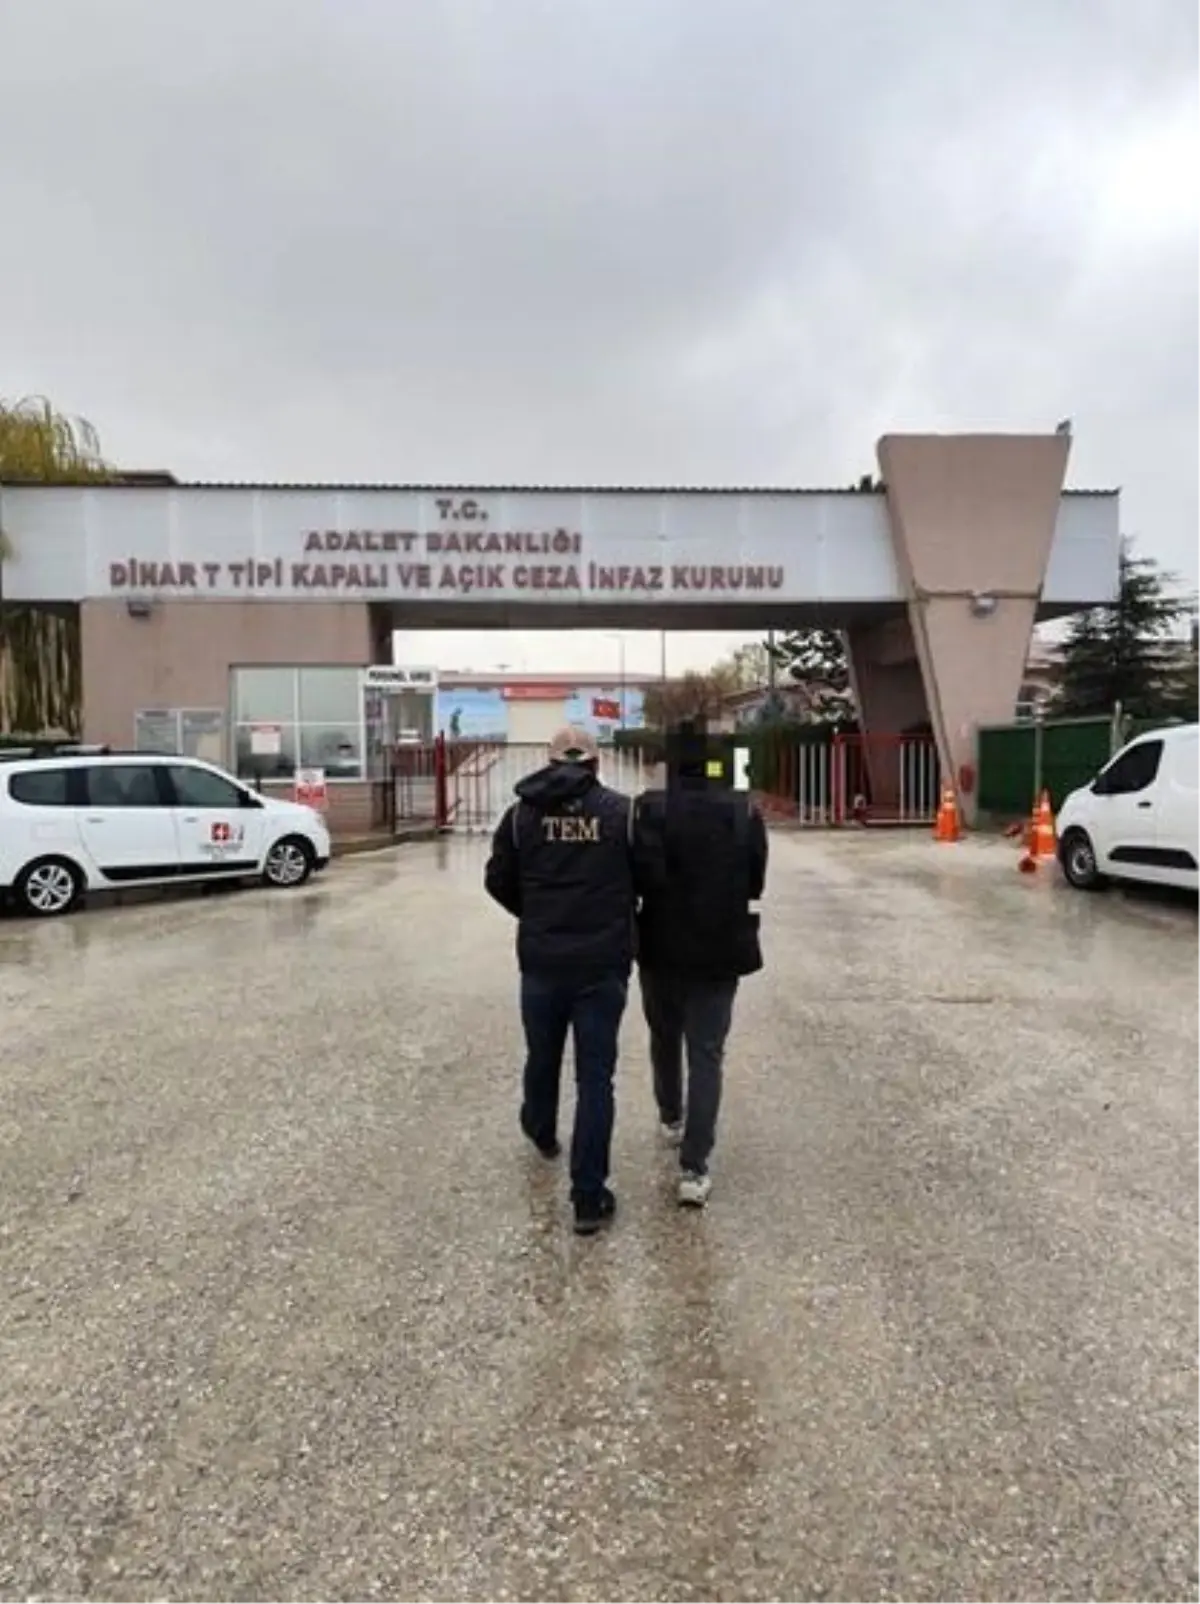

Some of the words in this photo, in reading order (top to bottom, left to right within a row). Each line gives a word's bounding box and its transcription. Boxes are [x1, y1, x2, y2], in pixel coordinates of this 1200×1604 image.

[435, 499, 489, 521] T.C.
[304, 531, 418, 551] ADALET
[426, 528, 582, 553] BAKANLIĞI
[203, 564, 221, 587] T
[228, 558, 282, 588] TİPİ
[291, 563, 387, 588] KAPALI
[398, 564, 431, 588] VE
[438, 564, 505, 593] AÇIK
[512, 564, 580, 589] CEZA
[589, 561, 664, 589] İNFAZ
[671, 564, 784, 589] KURUMU
[541, 815, 600, 841] TEM
